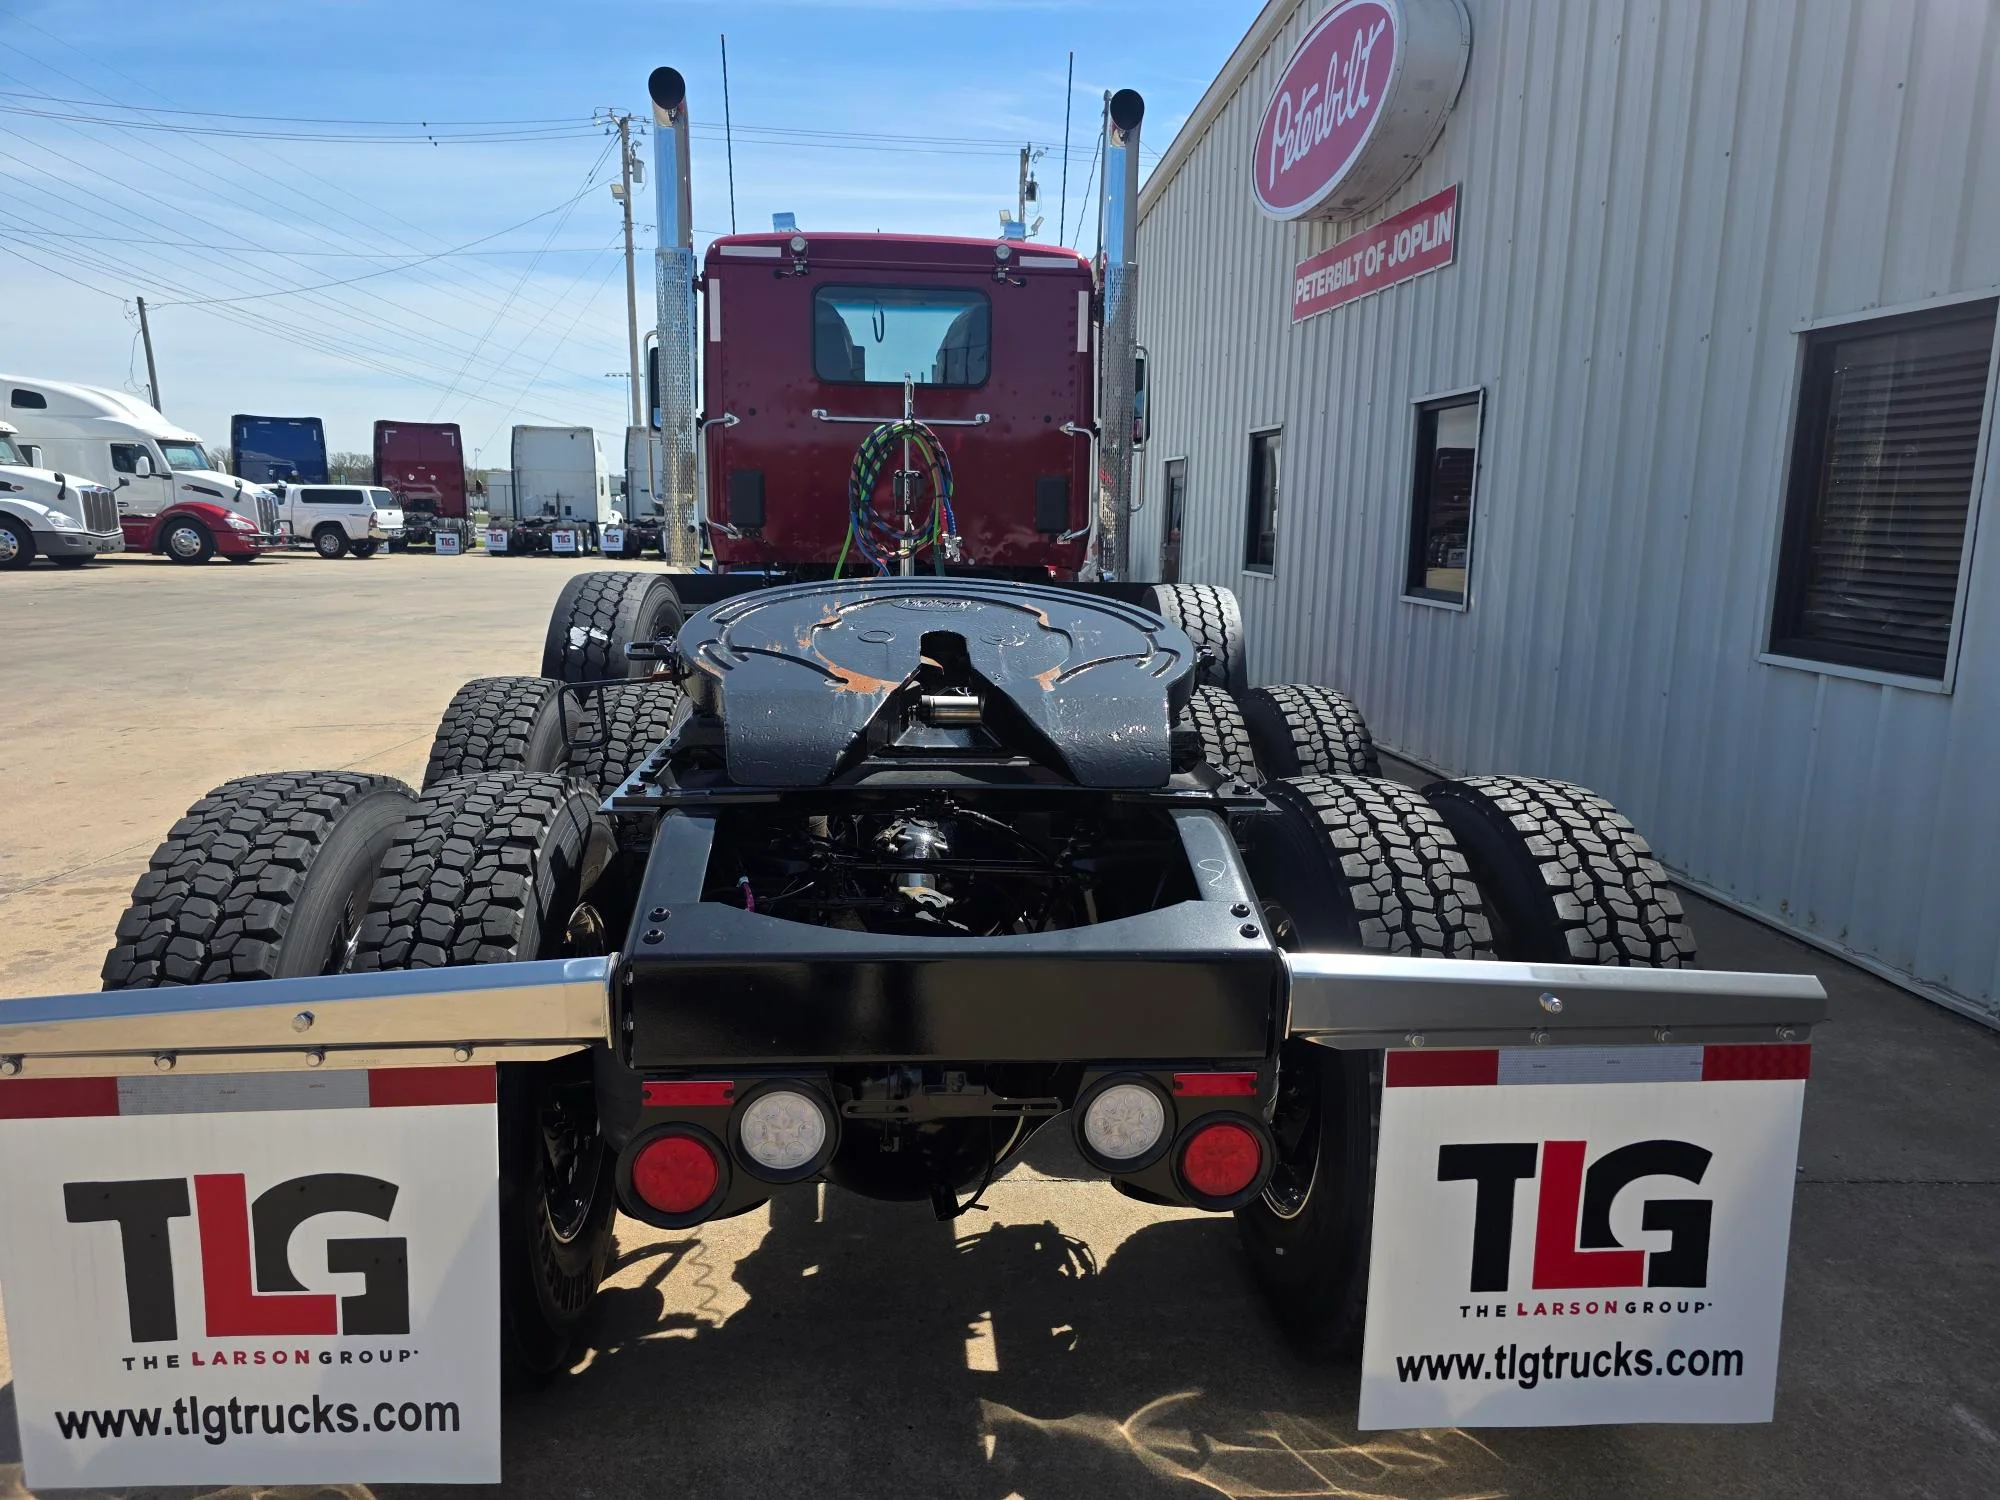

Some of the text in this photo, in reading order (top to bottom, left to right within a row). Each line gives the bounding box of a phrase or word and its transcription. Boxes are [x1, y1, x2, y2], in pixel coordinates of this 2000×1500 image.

[1269, 17, 1386, 191] Peterbilt
[1295, 206, 1453, 305] PETERBILT OF JOPLIN
[439, 537, 455, 547] TLG
[489, 533, 504, 543] TLG
[556, 534, 571, 544] TLG
[605, 534, 620, 543] TLG
[1437, 1139, 1714, 1293] TLG
[63, 1172, 411, 1343] TLG
[1460, 1301, 1706, 1318] THE LARSON GROUP
[122, 1349, 413, 1371] THE LARSON GROUP
[1396, 1341, 1744, 1389] www.tlgtrucks.com
[55, 1394, 461, 1445] www.tlgtrucks.com
